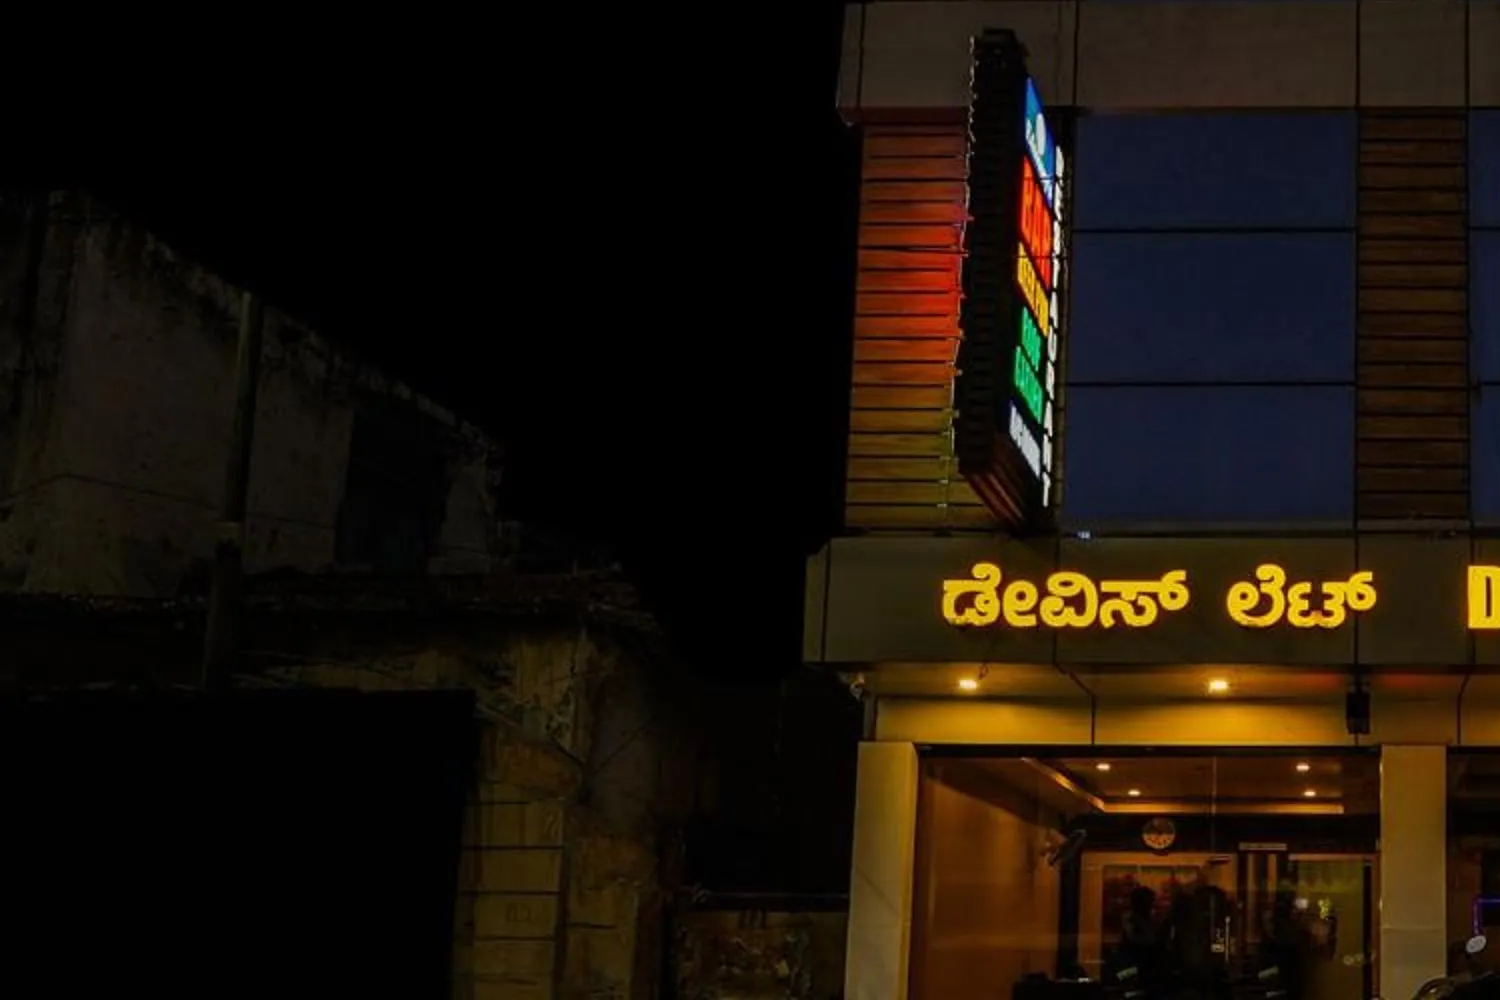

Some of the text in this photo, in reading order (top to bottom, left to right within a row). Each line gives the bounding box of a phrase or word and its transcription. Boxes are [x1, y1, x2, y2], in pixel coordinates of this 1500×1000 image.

[1021, 155, 1052, 290] BAR
[942, 563, 1376, 628] ಡೇವಿಸ್ ಲೆಟ್
